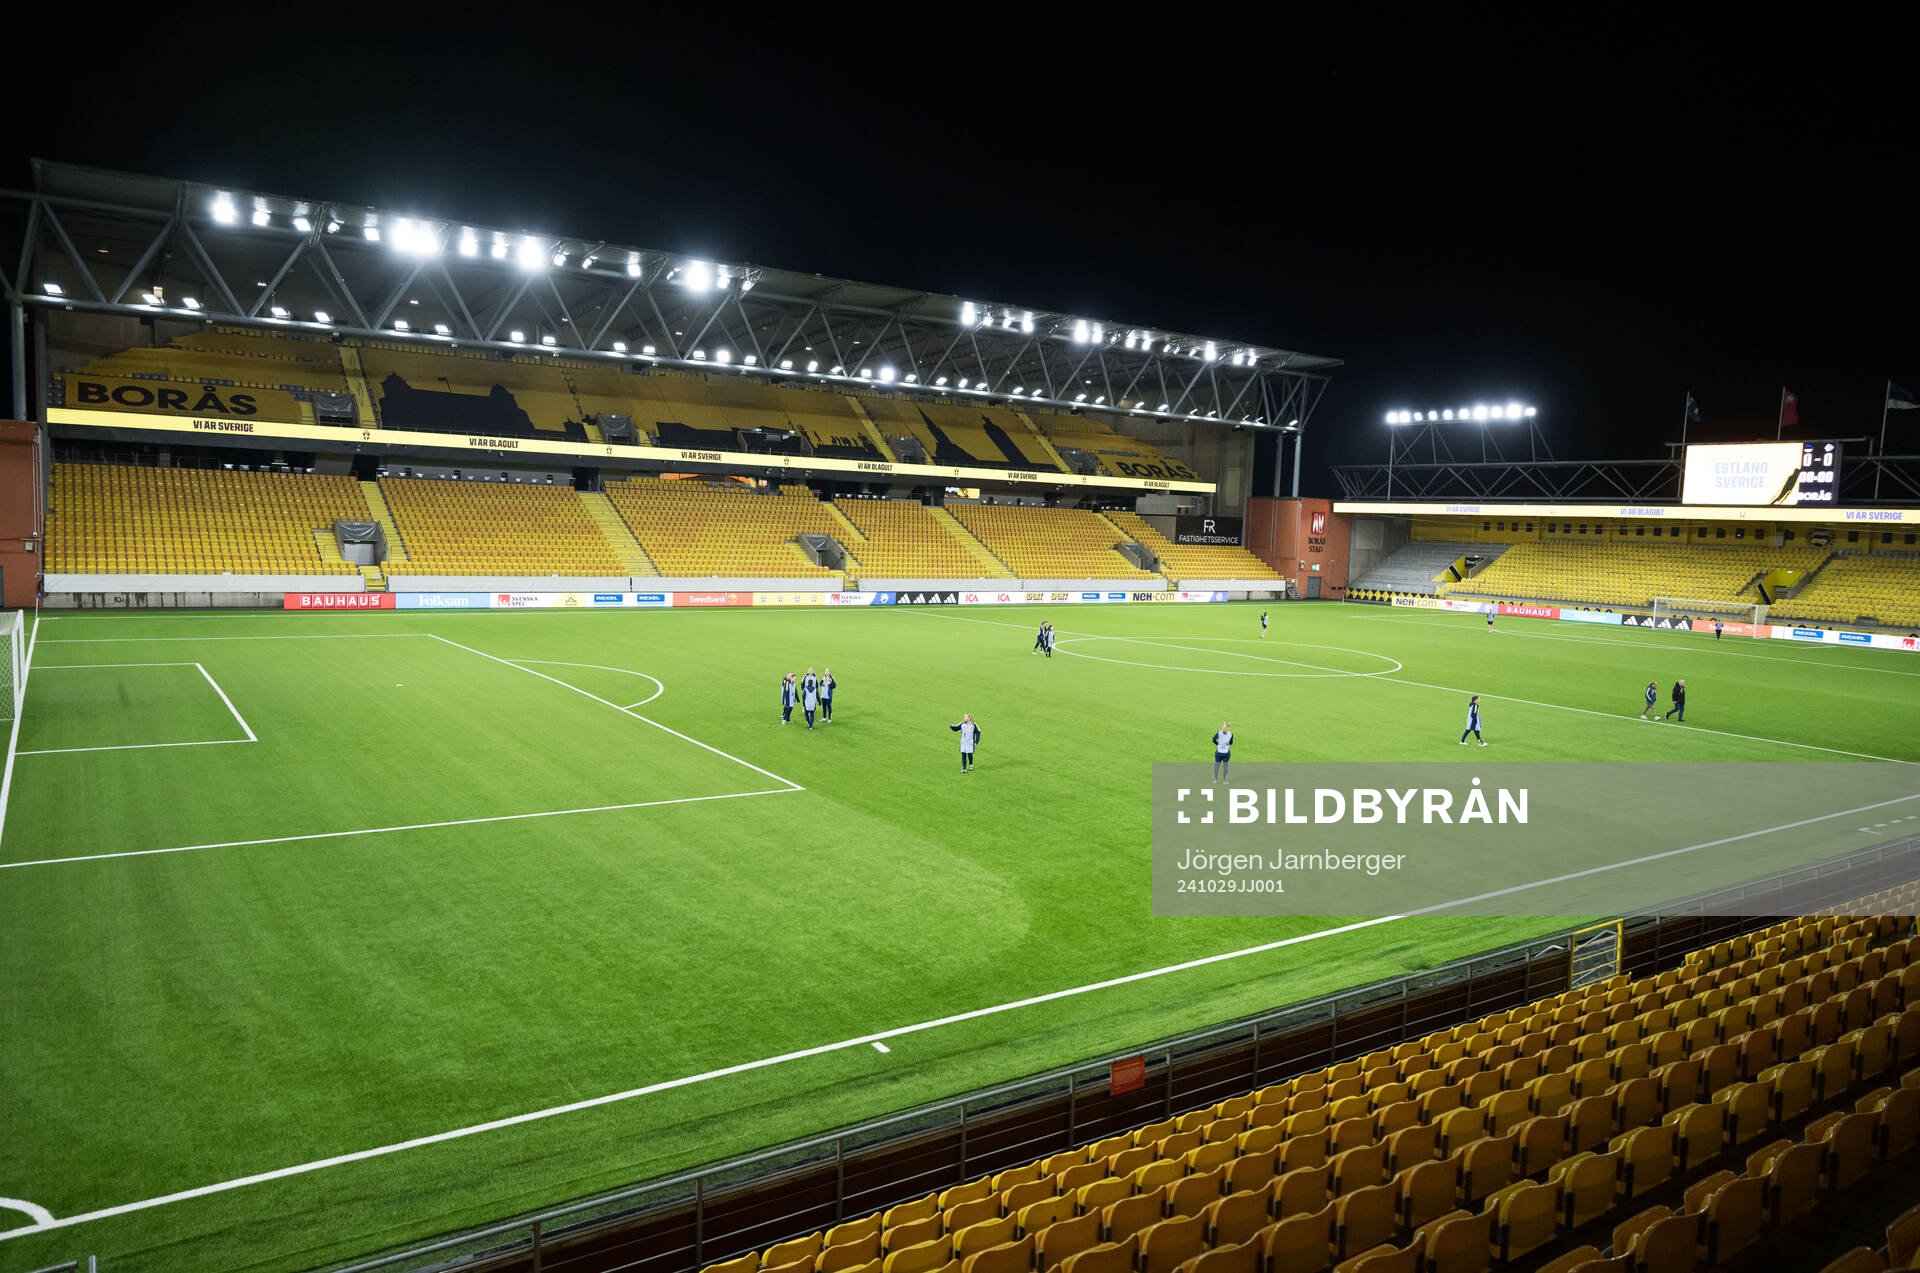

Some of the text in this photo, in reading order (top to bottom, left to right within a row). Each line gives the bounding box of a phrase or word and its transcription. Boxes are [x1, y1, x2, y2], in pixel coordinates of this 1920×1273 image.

[77, 382, 258, 416] BORÅS
[193, 420, 202, 429] VI
[218, 421, 254, 433] SVERIGE
[698, 452, 722, 461] SVERIGE
[1115, 460, 1195, 480] BORÅS
[1715, 462, 1768, 474] ESTLAND
[1715, 476, 1765, 489] SVERIGE
[1868, 512, 1903, 521] SVERIGE
[1178, 534, 1239, 544] FASTIGHETSSERVICE
[300, 593, 382, 608] BAUHAUS
[418, 593, 470, 608] Folksam
[688, 594, 728, 604] Swedbank
[965, 593, 979, 603] ICA
[997, 593, 1011, 603] ICA
[1506, 606, 1553, 618] BAUHAUS
